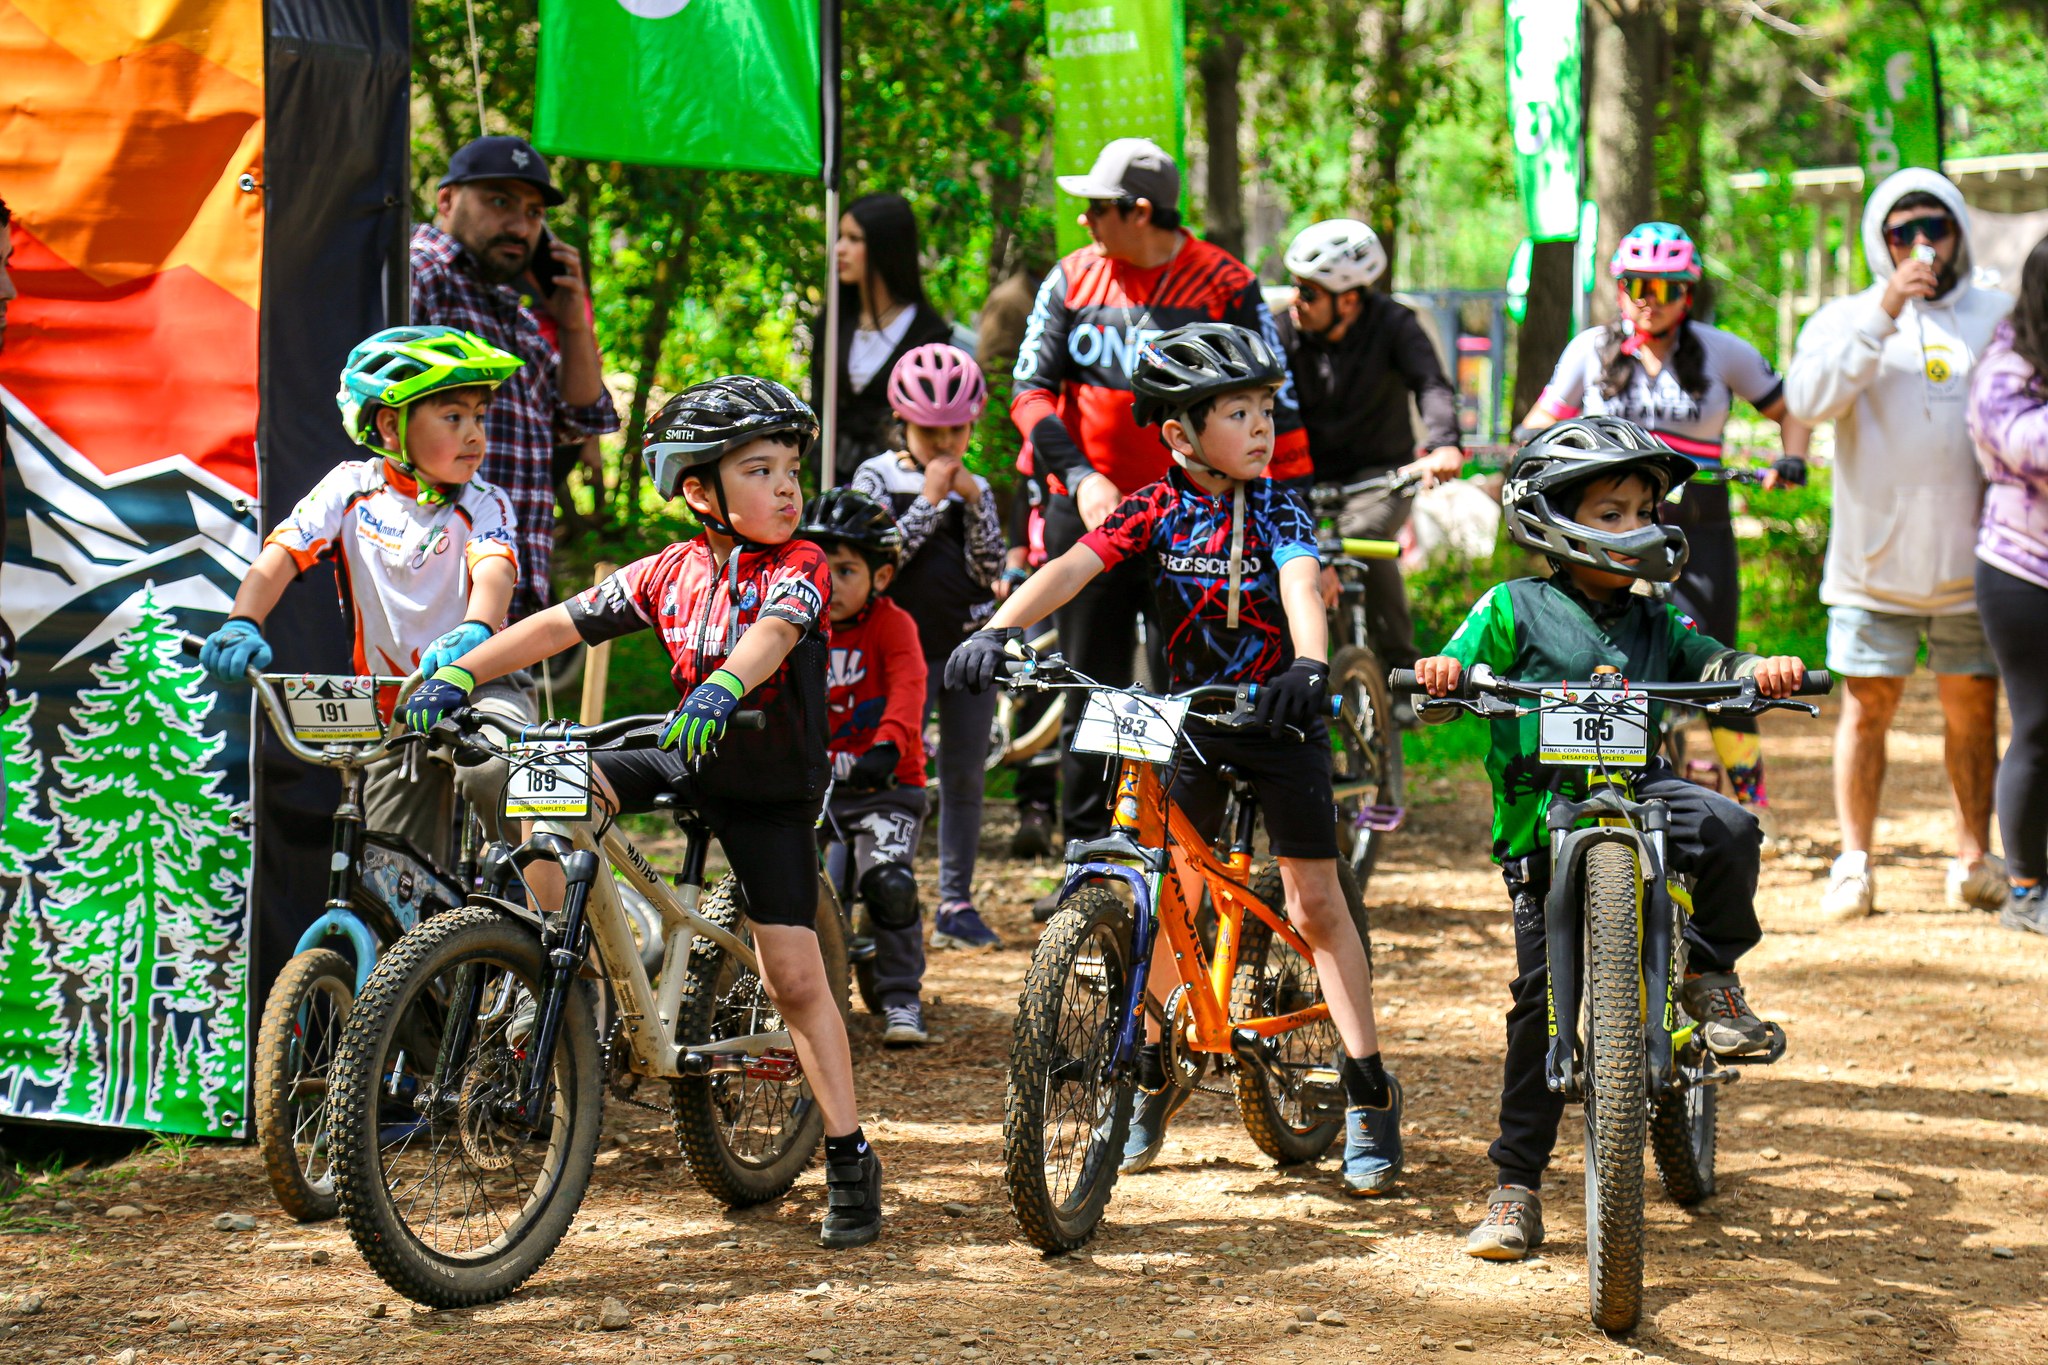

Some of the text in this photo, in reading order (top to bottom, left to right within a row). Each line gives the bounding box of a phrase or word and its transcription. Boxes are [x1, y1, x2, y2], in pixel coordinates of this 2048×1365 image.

[665, 430, 695, 440] SMITH
[695, 688, 730, 705] FLY
[316, 702, 348, 722] 191
[1573, 718, 1614, 741] 185
[526, 768, 557, 792] 189
[626, 842, 658, 883] MATTEO
